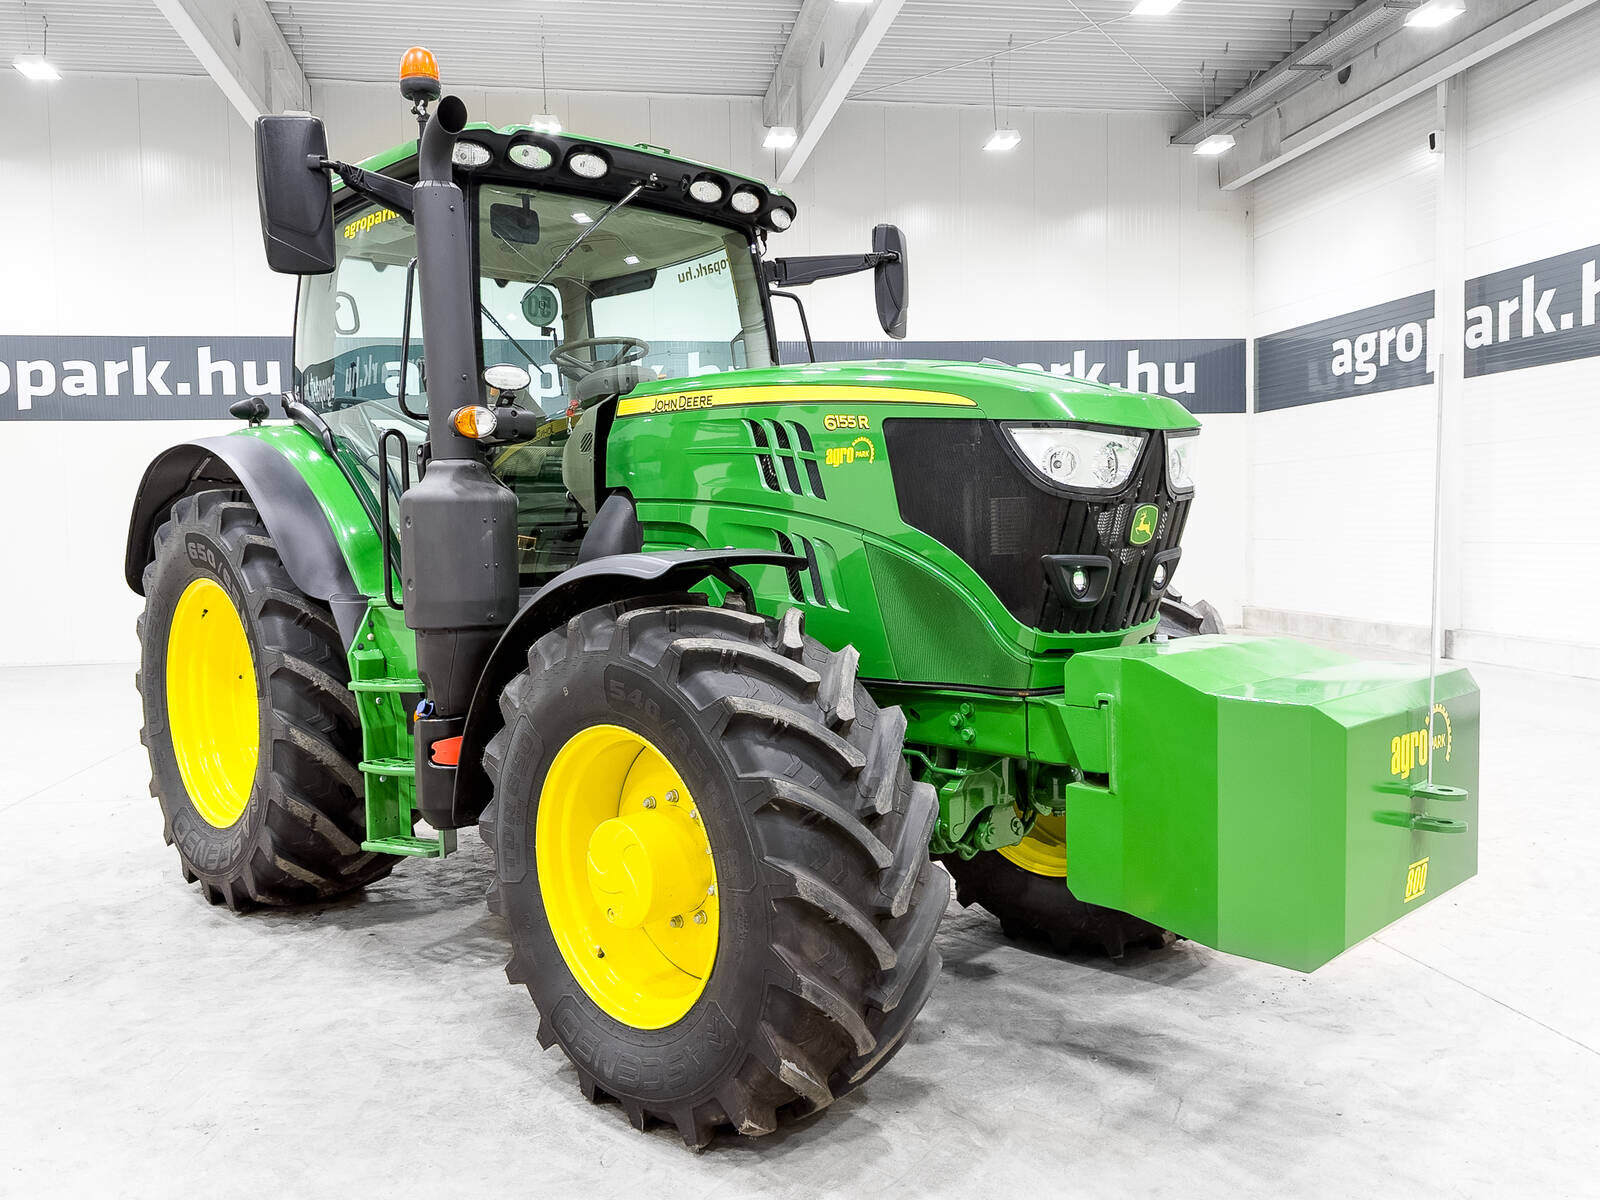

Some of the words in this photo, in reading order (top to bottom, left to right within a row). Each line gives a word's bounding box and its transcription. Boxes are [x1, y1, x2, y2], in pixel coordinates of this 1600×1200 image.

[1017, 350, 1196, 394] k.hu
[651, 397, 678, 413] JOHN
[678, 395, 713, 410] DEERE
[825, 447, 854, 468] agro
[1391, 729, 1428, 779] agro
[1404, 863, 1428, 897] 800
